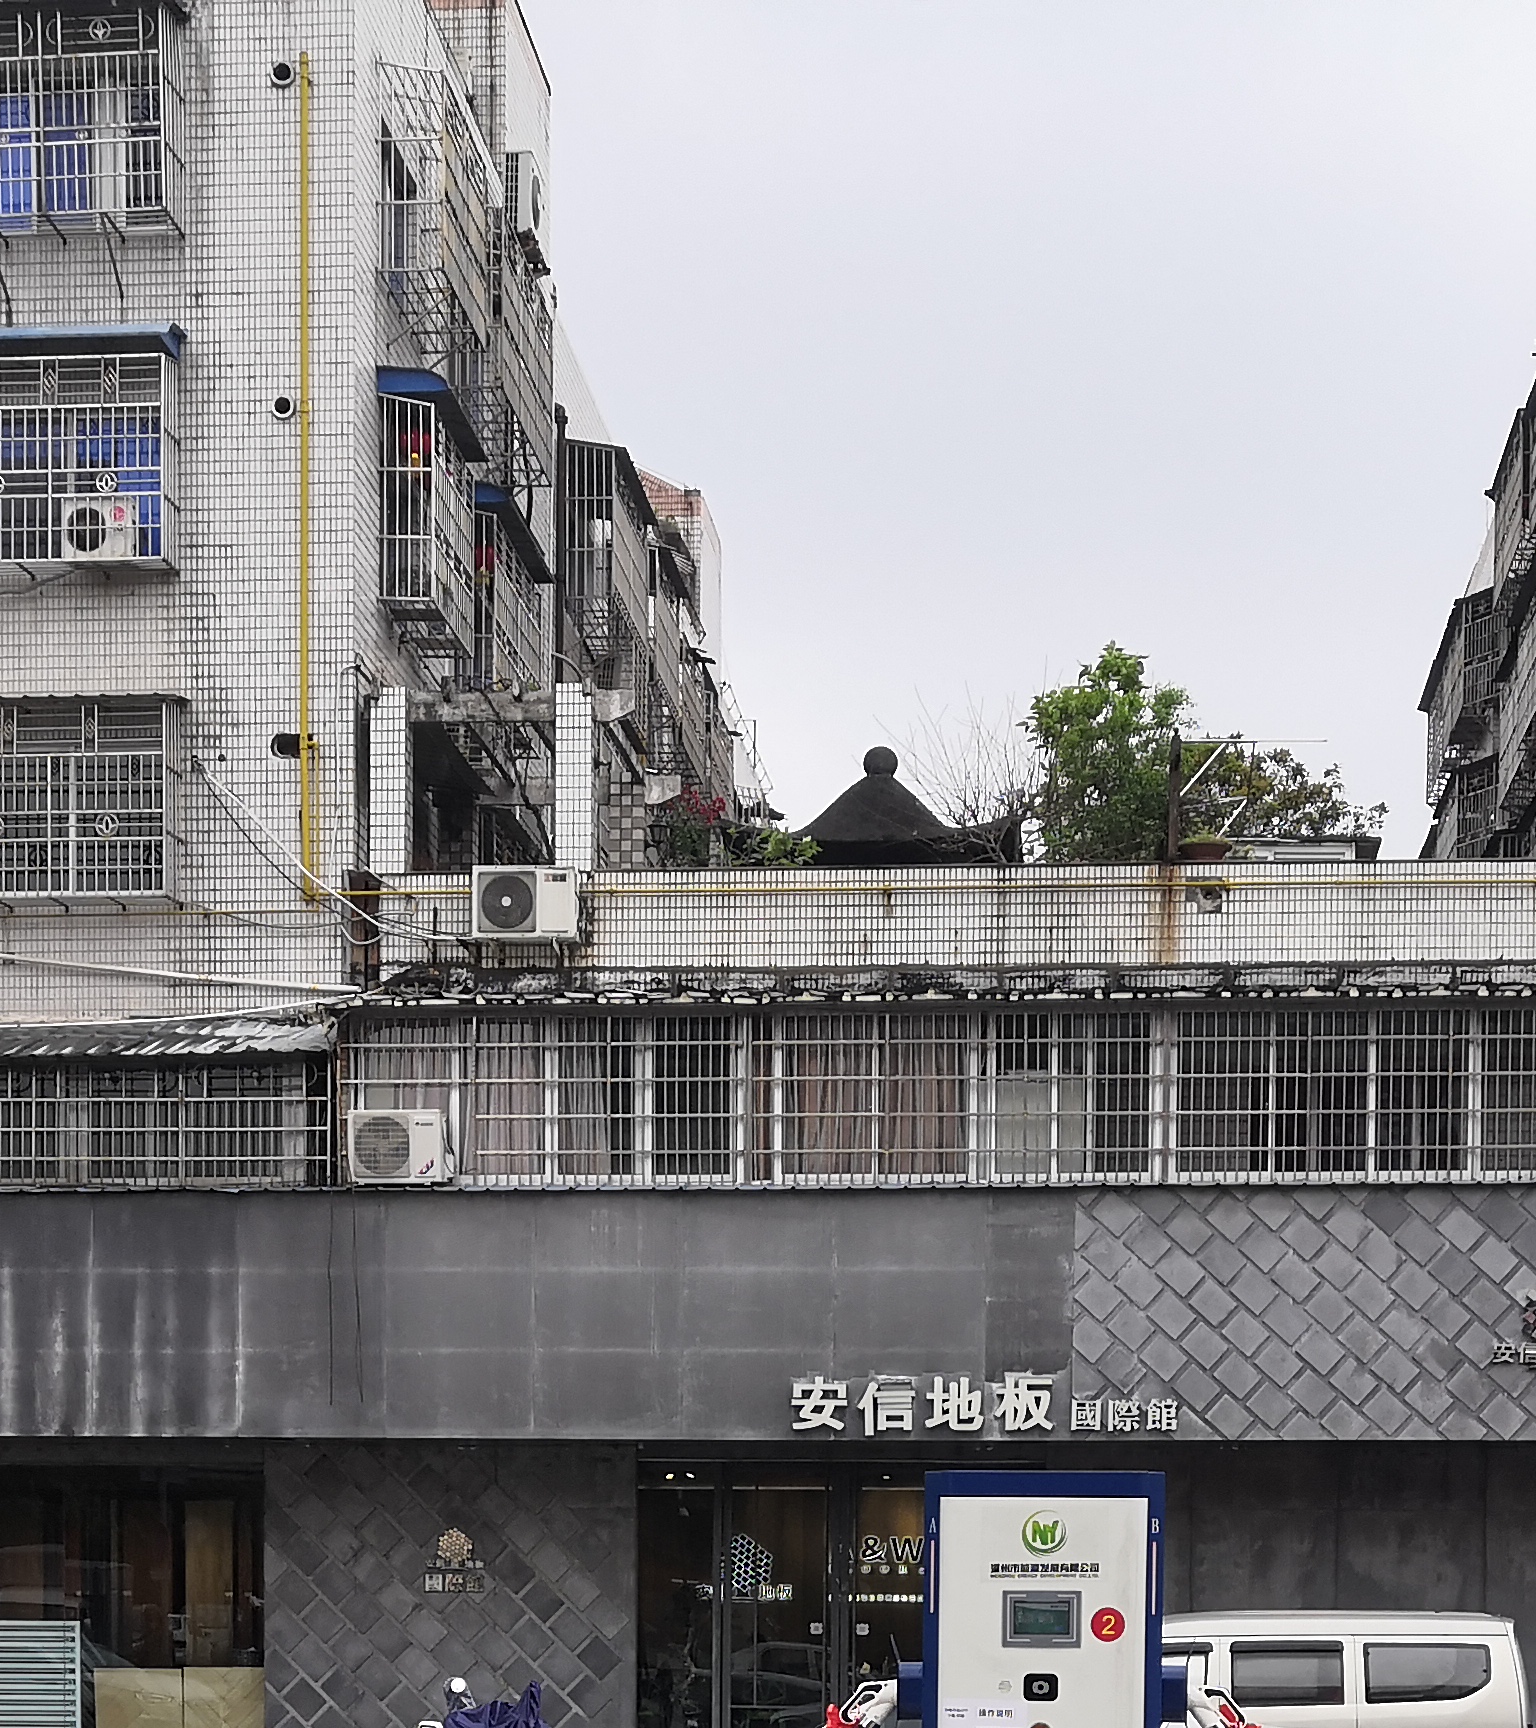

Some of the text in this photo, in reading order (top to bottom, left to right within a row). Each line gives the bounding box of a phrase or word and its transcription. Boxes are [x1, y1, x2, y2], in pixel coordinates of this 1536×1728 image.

[791, 1376, 1054, 1436] 安信地板
[1071, 1398, 1179, 1432] 國際館
[929, 1517, 937, 1534] A
[1151, 1518, 1160, 1534] B
[848, 1535, 925, 1563] &W
